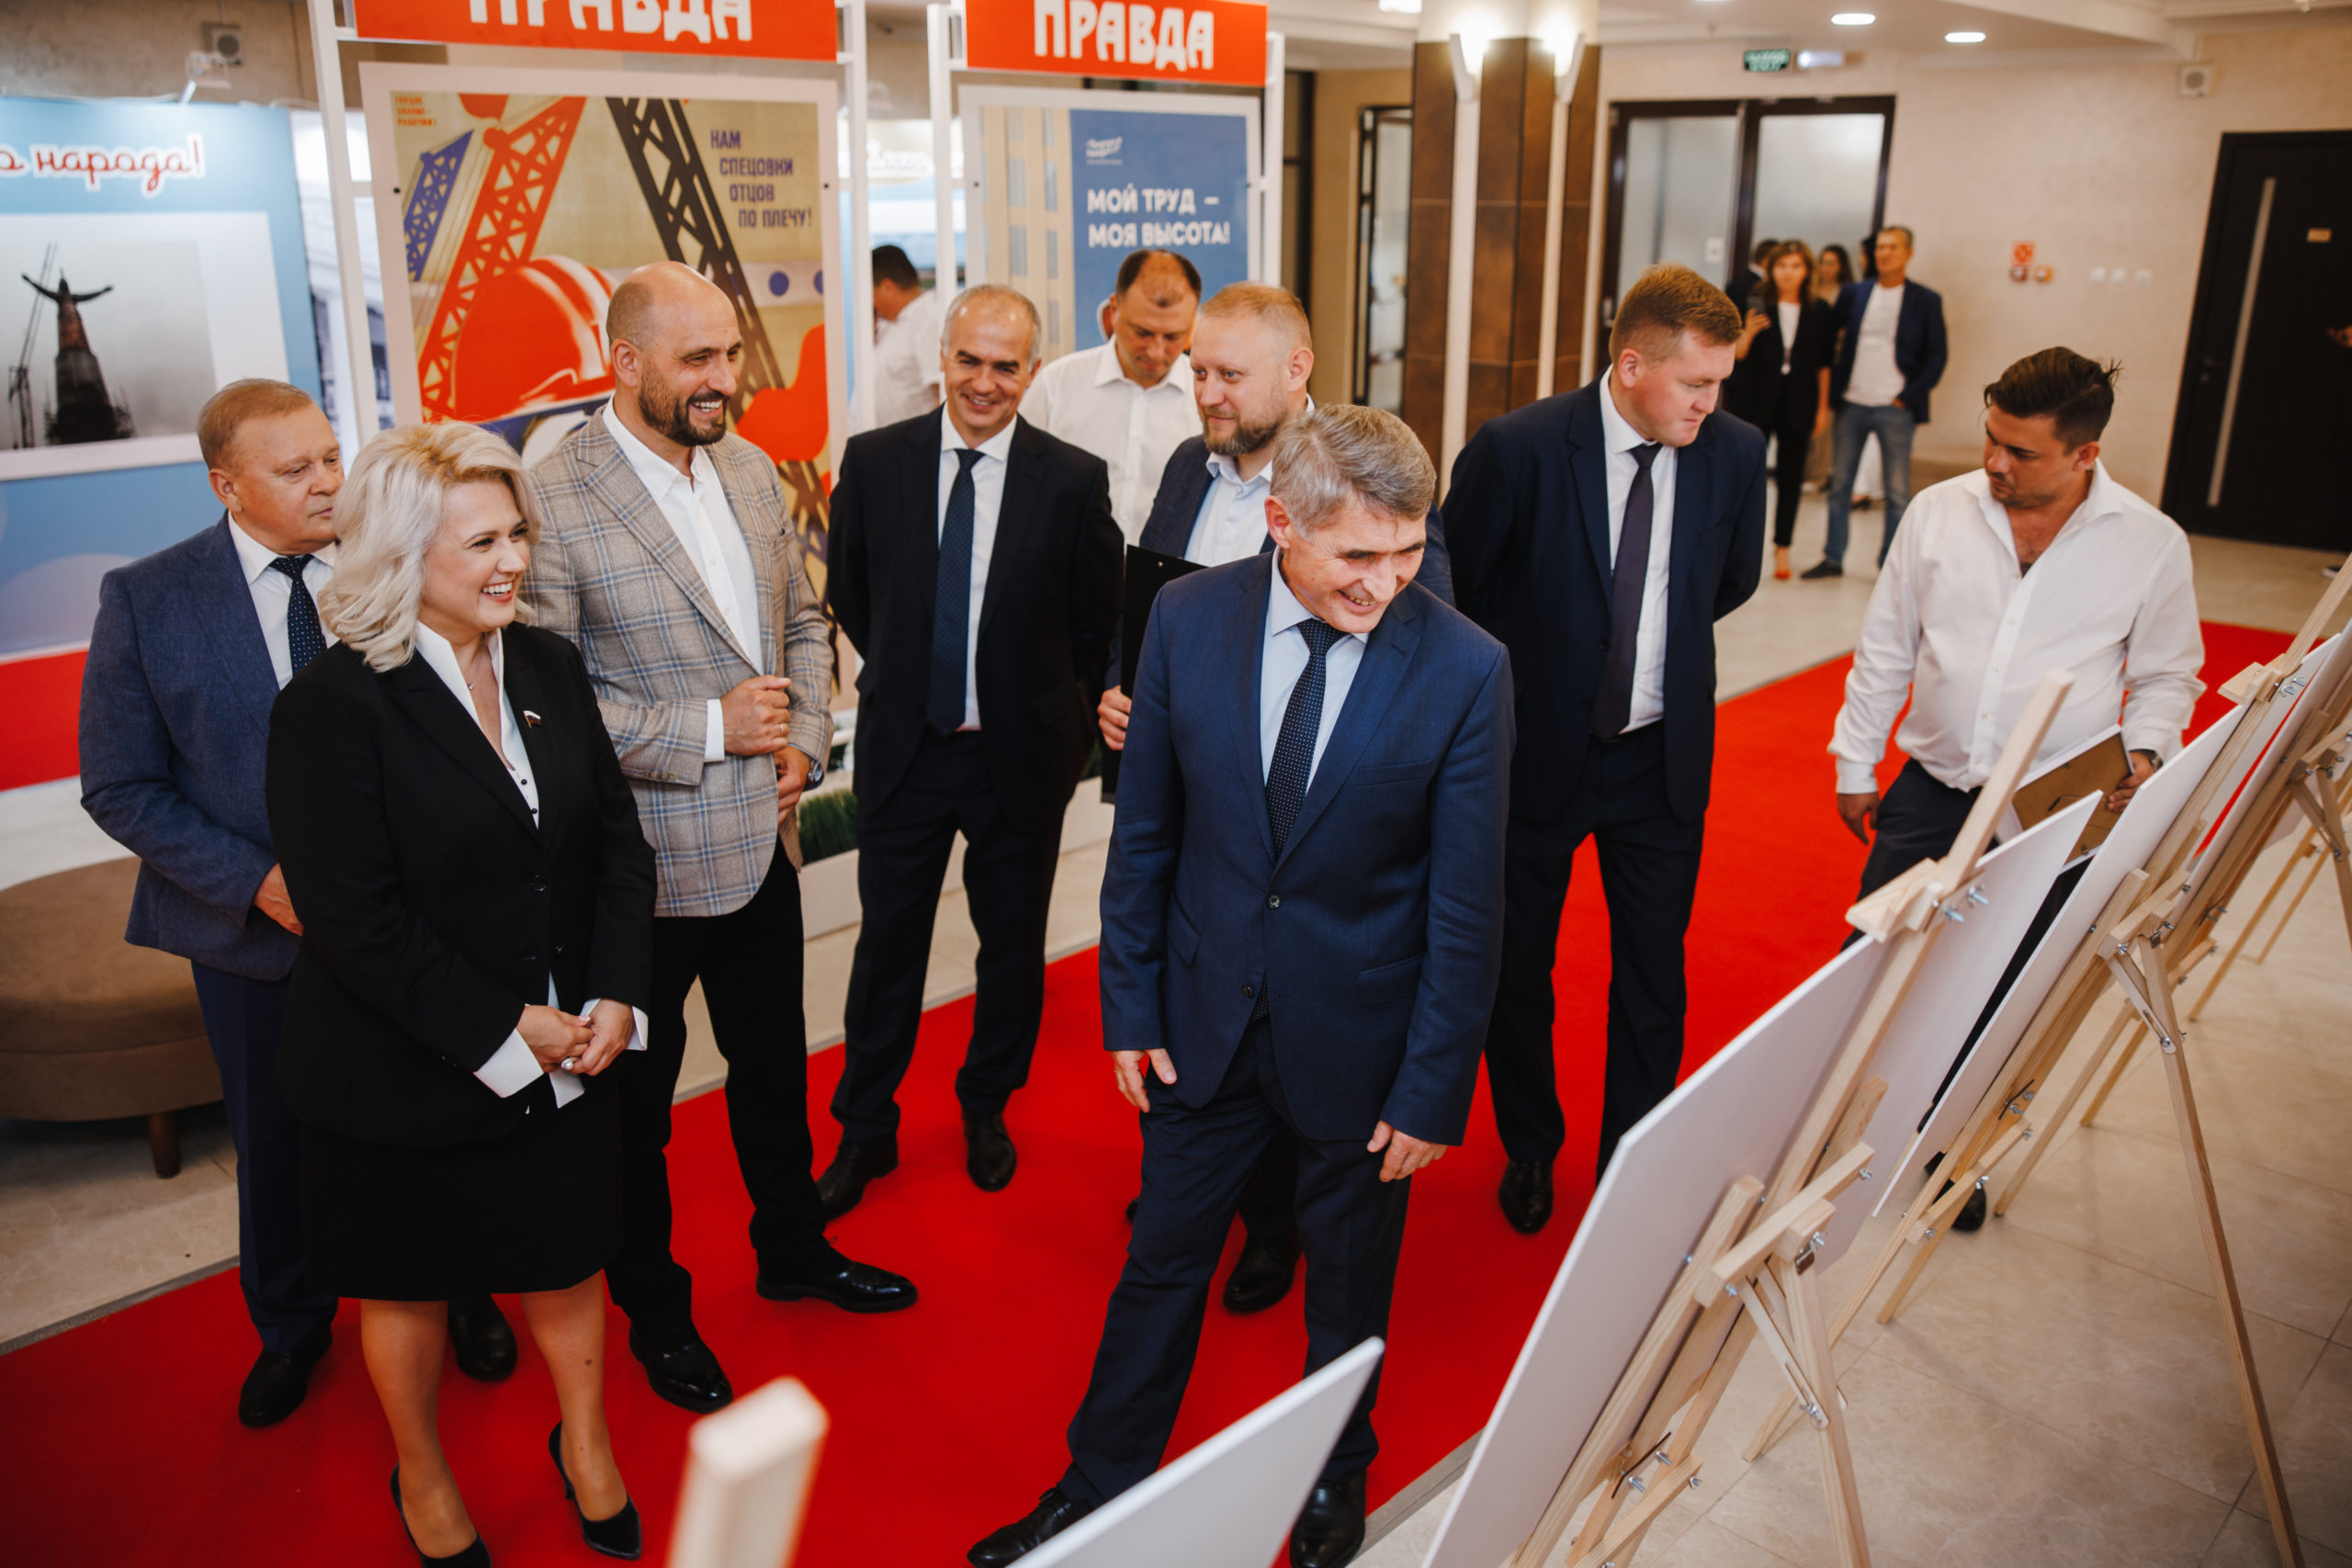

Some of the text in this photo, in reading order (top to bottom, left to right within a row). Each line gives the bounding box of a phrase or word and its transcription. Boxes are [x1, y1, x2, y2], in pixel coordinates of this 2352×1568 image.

[1034, 0, 1214, 72] ПРАВДА
[710, 130, 741, 149] НАМ
[33, 138, 202, 194] народа!
[729, 184, 774, 202] ОТЦОВ
[1087, 183, 1138, 213] МОЙ
[1142, 188, 1196, 215] ТРУД
[739, 207, 811, 227] ПО ПЛЕЧУ!
[1088, 220, 1230, 248] МОЯ ВЫСОТА!
